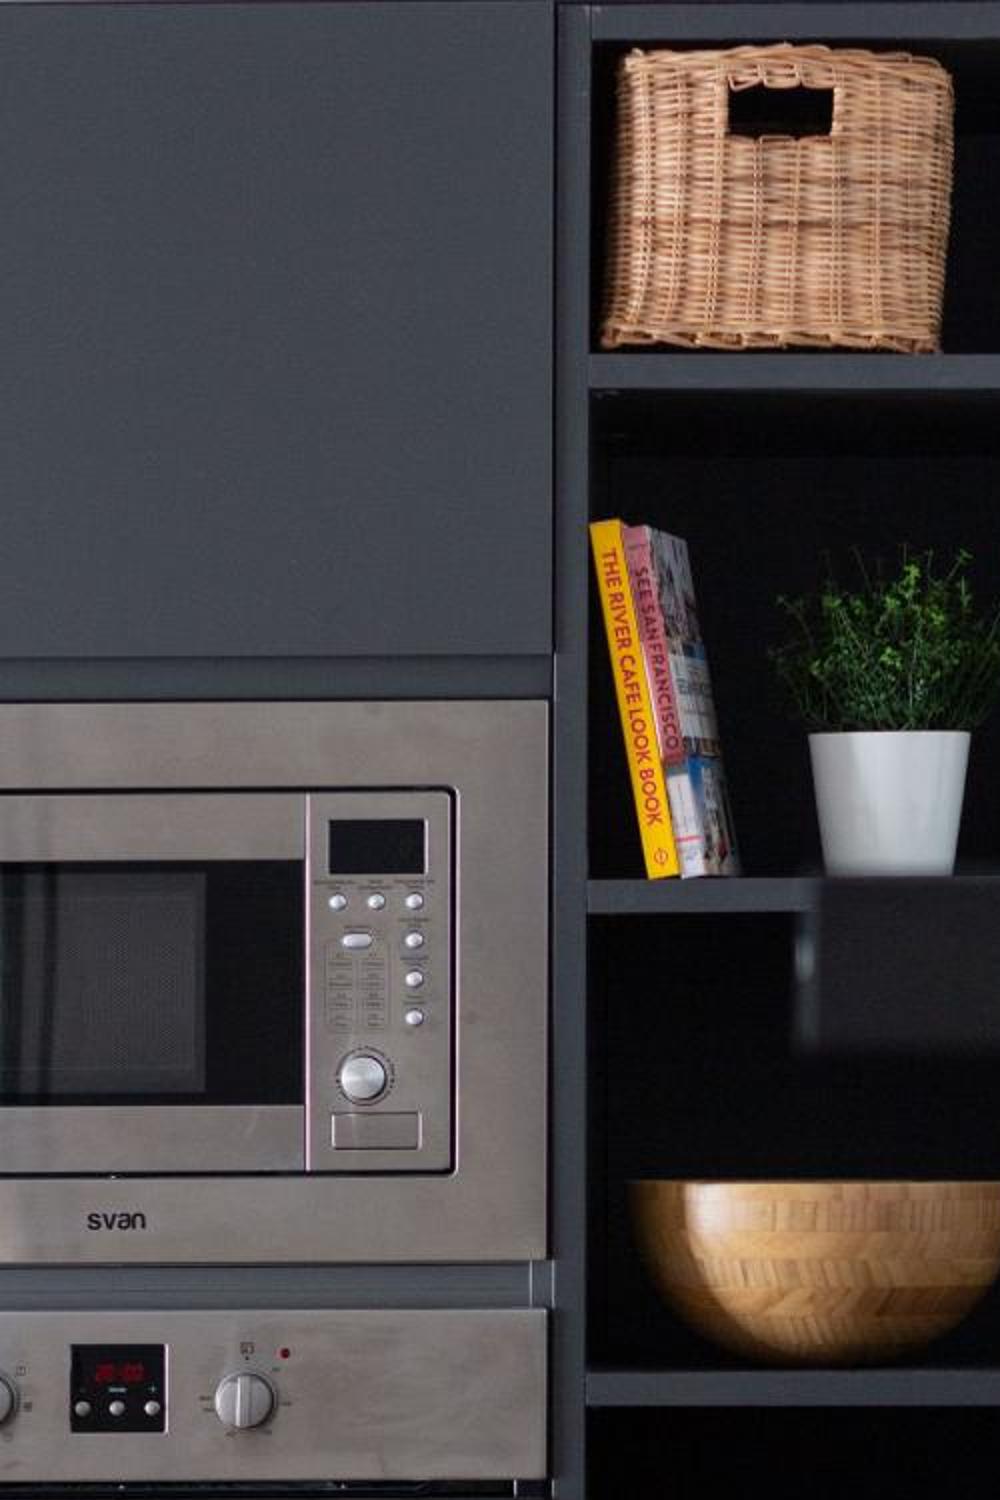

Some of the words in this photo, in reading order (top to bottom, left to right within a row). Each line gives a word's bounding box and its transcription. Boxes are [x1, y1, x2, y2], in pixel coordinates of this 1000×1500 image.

[603, 548, 622, 588] THE
[635, 567, 653, 599] SEE
[609, 592, 632, 650] RIVER
[620, 655, 641, 704] CAFE
[629, 708, 652, 765] LOOK
[640, 767, 663, 826] BOOK
[87, 1213, 146, 1230] svan
